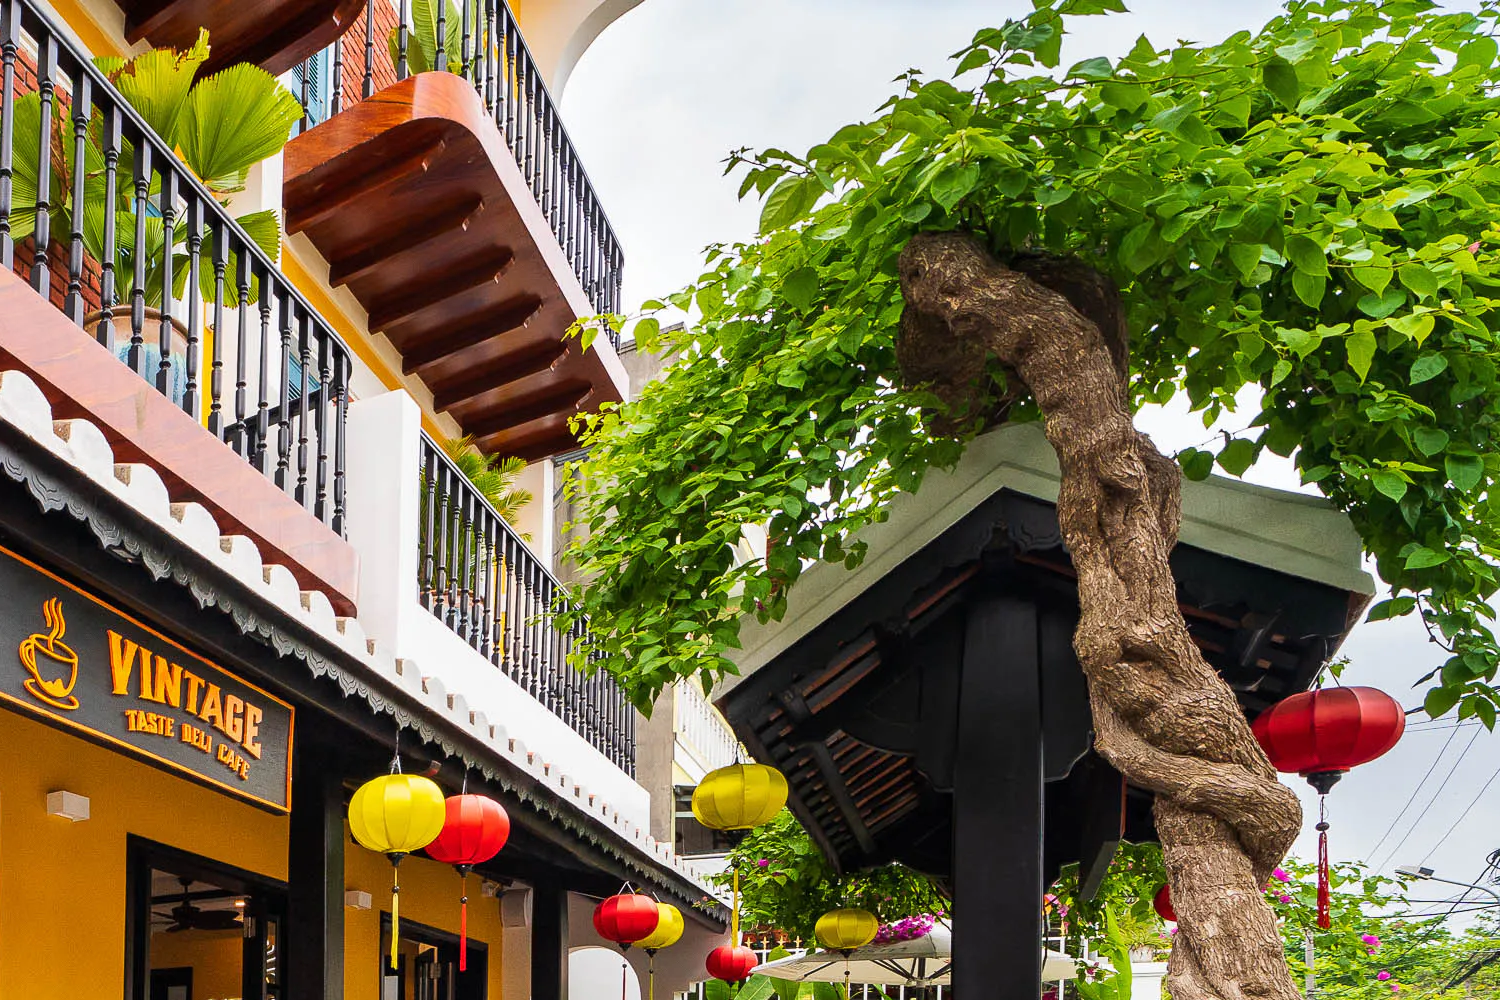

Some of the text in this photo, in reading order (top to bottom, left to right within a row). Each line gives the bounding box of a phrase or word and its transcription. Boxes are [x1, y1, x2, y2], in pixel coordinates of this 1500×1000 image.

[107, 629, 263, 760] VINTAGE
[124, 709, 250, 780] TASTE DELI CAFE
